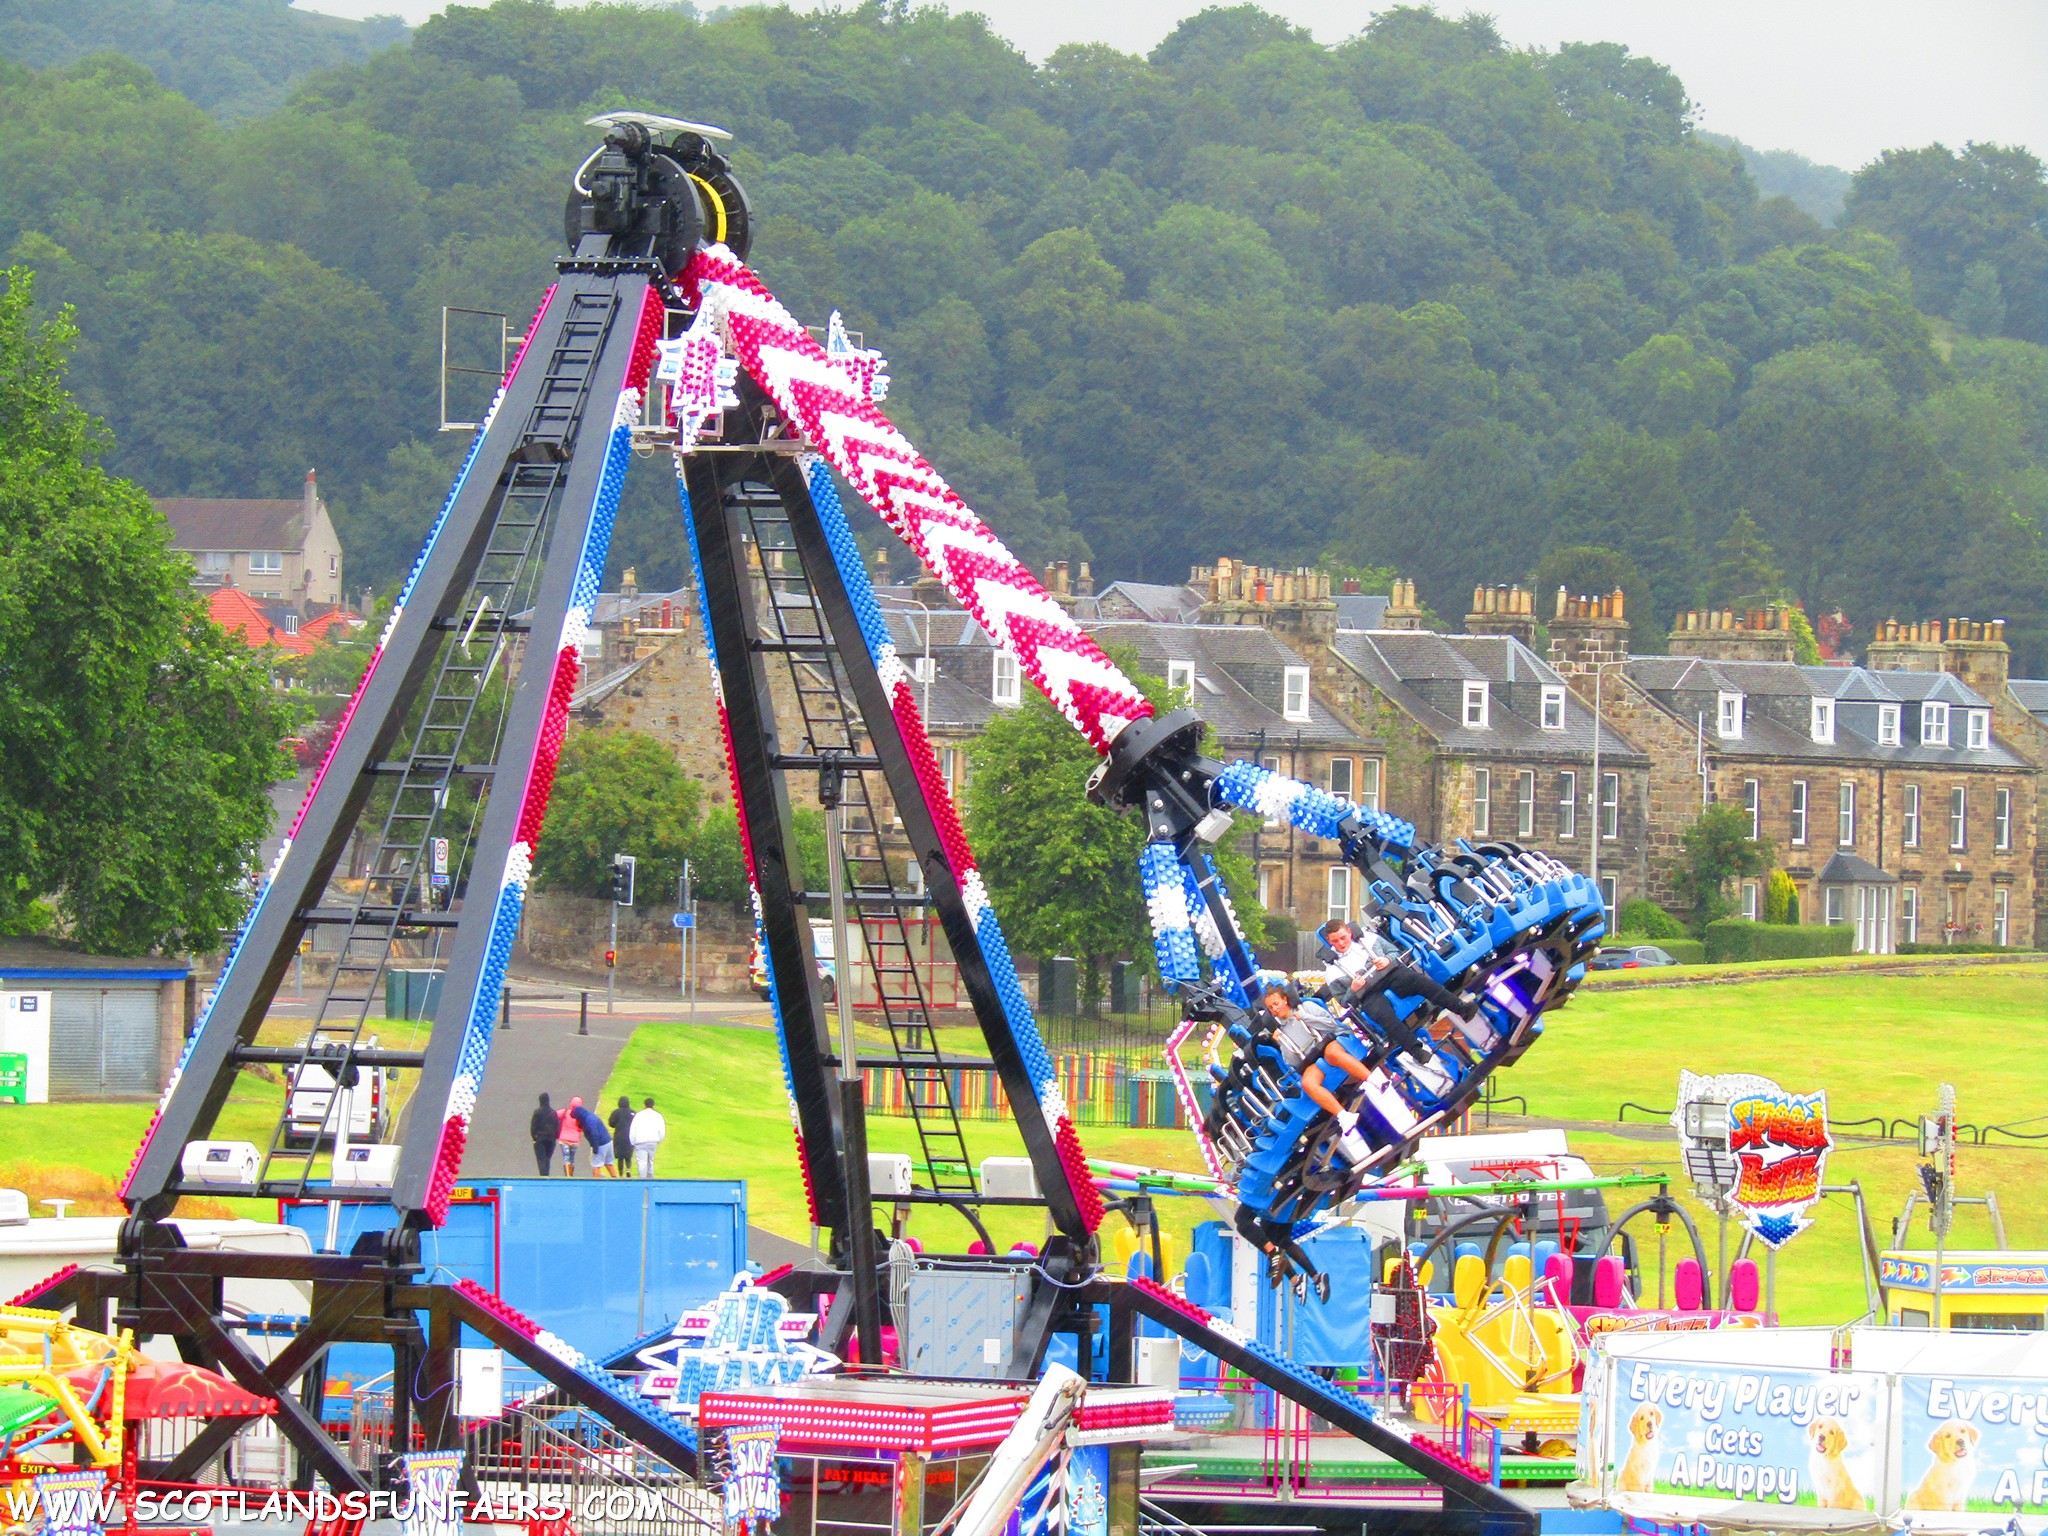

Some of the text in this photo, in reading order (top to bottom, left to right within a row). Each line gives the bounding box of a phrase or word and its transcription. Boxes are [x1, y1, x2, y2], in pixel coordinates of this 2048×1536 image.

[437, 846, 445, 855] 20
[711, 1293, 783, 1353] AIR
[1629, 1362, 1727, 1421] Every
[1734, 1374, 1861, 1427] Player
[1705, 1422, 1764, 1455] Gets
[20, 1464, 45, 1473] EXIT
[737, 1439, 771, 1477] SKY
[824, 1468, 888, 1484] PAY HERE
[728, 1475, 777, 1517] DIVER
[1670, 1452, 1799, 1504] A Puppy
[1992, 1469, 2023, 1506] A
